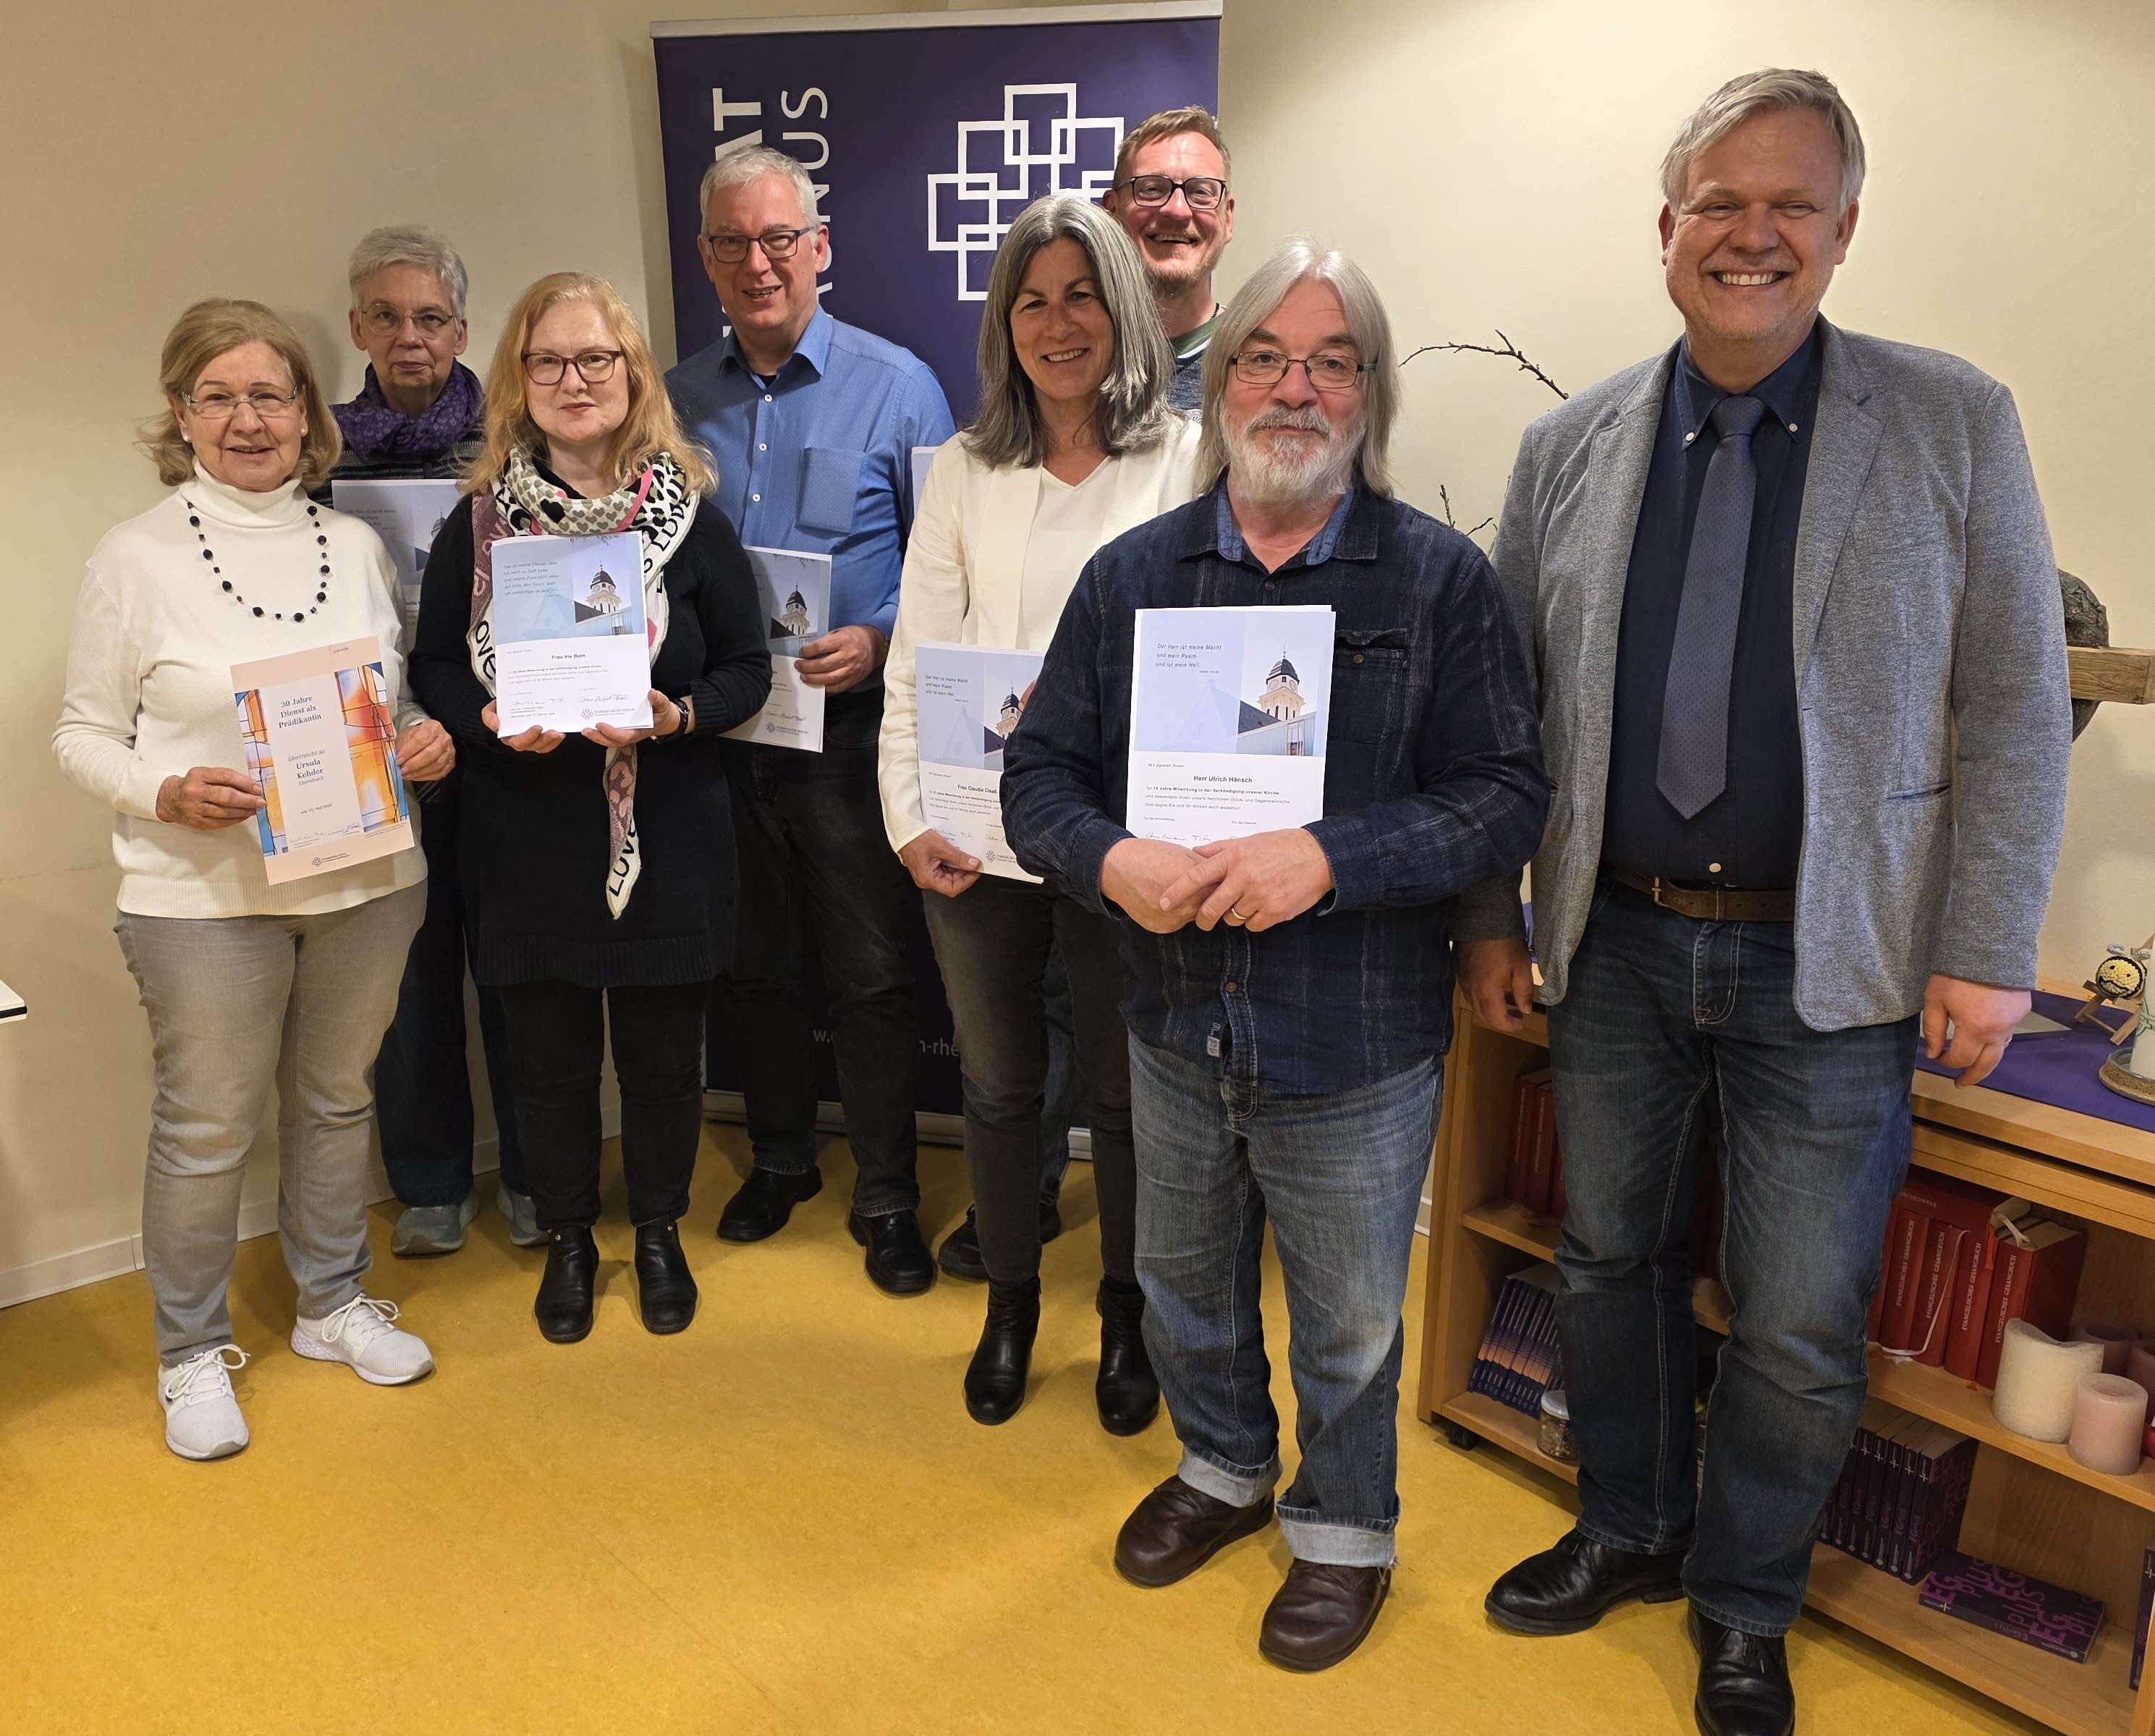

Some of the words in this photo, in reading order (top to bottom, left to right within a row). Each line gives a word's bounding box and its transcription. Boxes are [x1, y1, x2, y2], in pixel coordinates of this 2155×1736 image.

[280, 707, 305, 718] Dienst
[292, 696, 313, 706] Jahre
[278, 713, 322, 728] Prädikantin
[287, 750, 318, 762] überreicht
[296, 758, 321, 769] Ursula
[297, 769, 323, 779] Kehder
[1962, 1284, 1975, 1331] EVANGELISCHES
[1970, 1242, 1982, 1284] GESANGBUCH
[1995, 1297, 2009, 1344] EVANGELISCHES
[2004, 1254, 2017, 1296] GESANGBUCH
[1920, 1571, 1962, 1604] EG
[1986, 1564, 2027, 1601] EG
[2002, 1587, 2045, 1629] plus
[2029, 1610, 2073, 1645] EG
